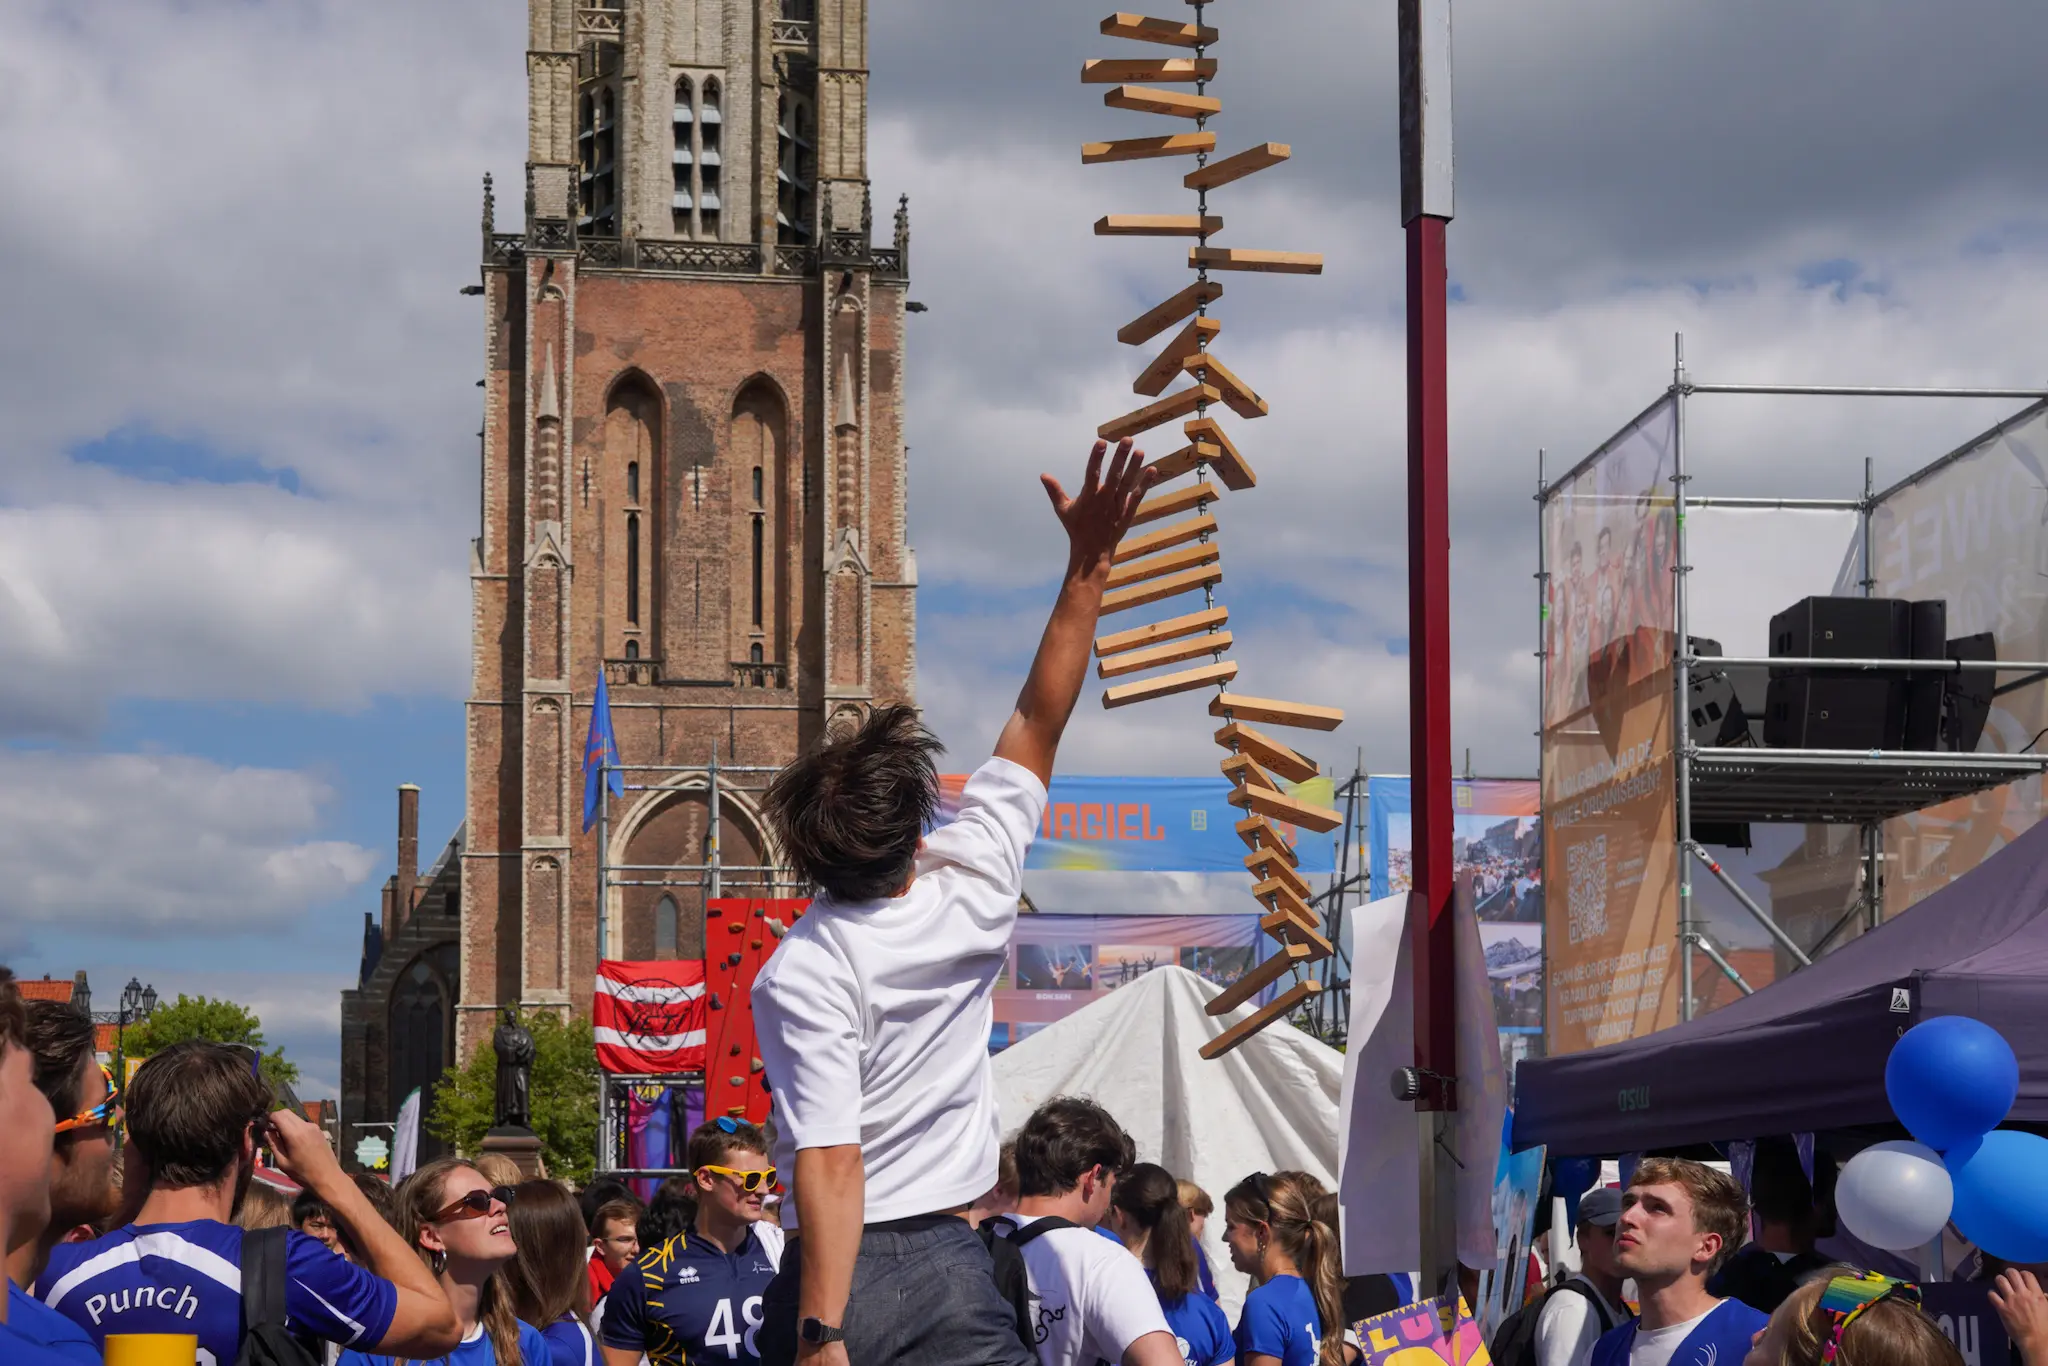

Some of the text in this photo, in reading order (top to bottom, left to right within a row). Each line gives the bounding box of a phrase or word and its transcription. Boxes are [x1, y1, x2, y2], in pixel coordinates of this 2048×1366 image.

[1637, 738, 1653, 763] DE
[1588, 982, 1600, 1000] OP
[1612, 968, 1664, 995] BRABANTSE
[1563, 1001, 1610, 1025] TURFMARKT
[1610, 996, 1635, 1017] VOOR
[84, 1284, 200, 1326] Punch
[704, 1295, 765, 1360] 48
